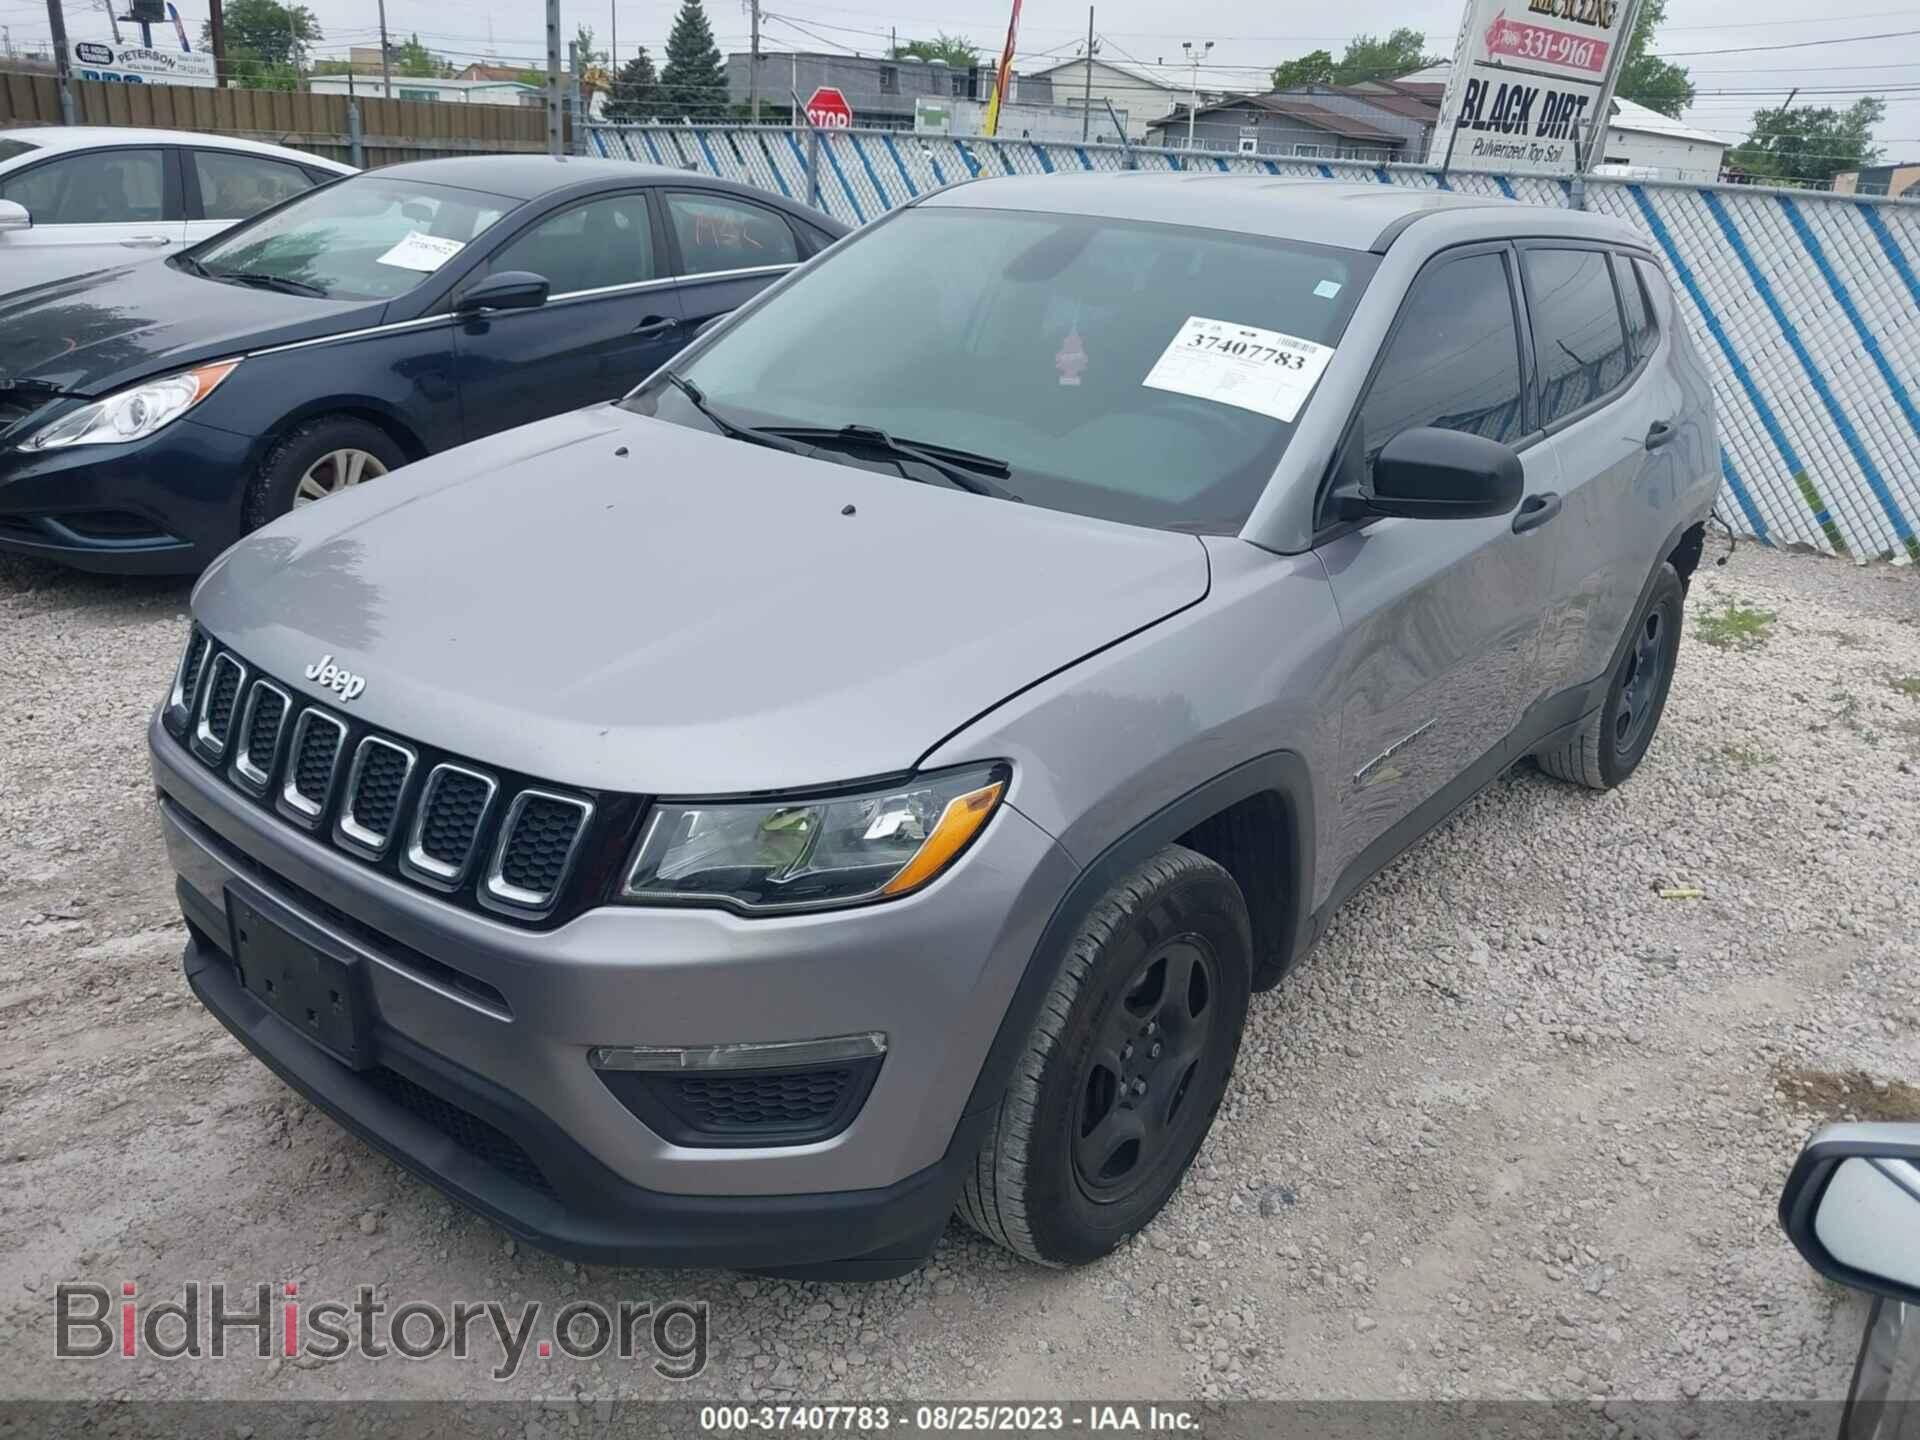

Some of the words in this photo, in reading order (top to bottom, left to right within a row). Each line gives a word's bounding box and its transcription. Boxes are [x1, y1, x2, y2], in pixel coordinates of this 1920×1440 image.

[117, 49, 177, 69] PETERSON
[1517, 29, 1595, 67] 331-9161
[808, 109, 848, 129] STOP
[1457, 78, 1539, 135] BLACK
[1536, 90, 1589, 141] DIRT
[1527, 142, 1545, 165] Top
[1544, 145, 1564, 163] Soil
[1187, 333, 1306, 370] 37407783
[305, 654, 367, 703] Jeep
